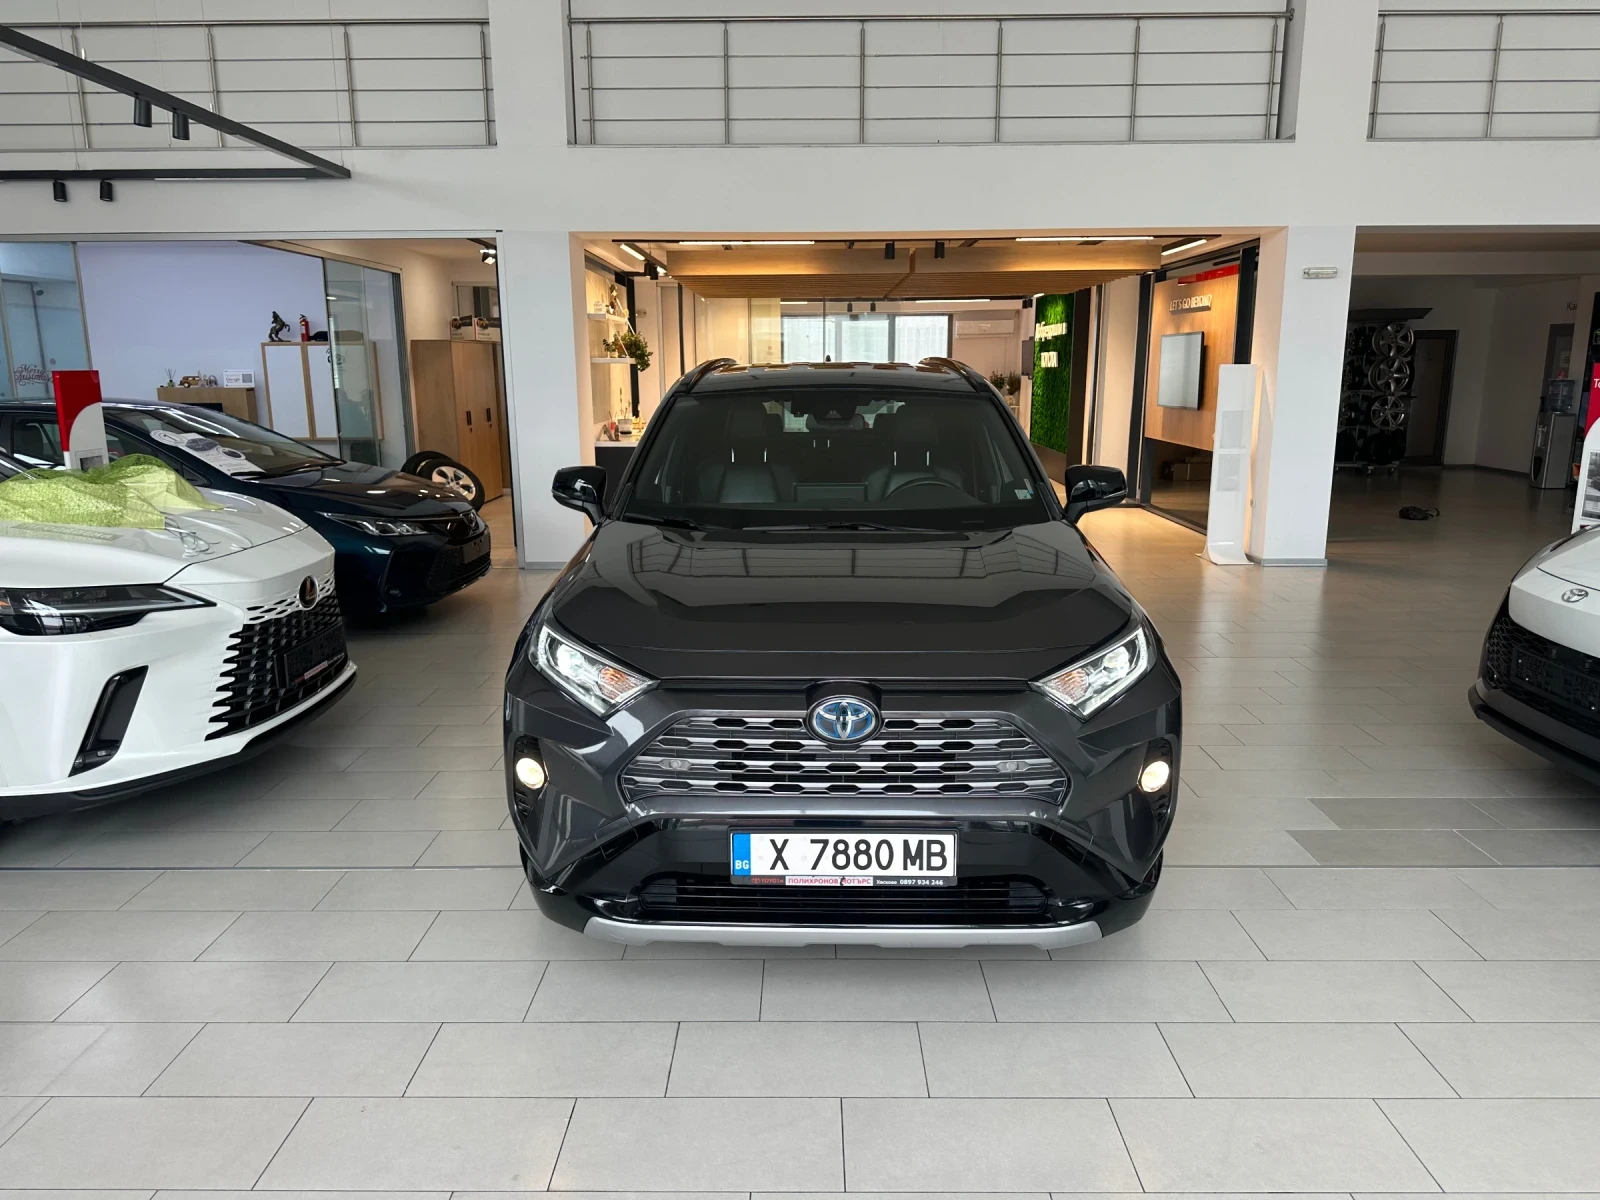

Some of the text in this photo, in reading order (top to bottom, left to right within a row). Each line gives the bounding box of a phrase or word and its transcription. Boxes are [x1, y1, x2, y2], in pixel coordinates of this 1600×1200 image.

[769, 838, 948, 871] X 7880 MB
[735, 860, 750, 870] BG
[788, 877, 839, 885] ПОЛИХРОНОВ
